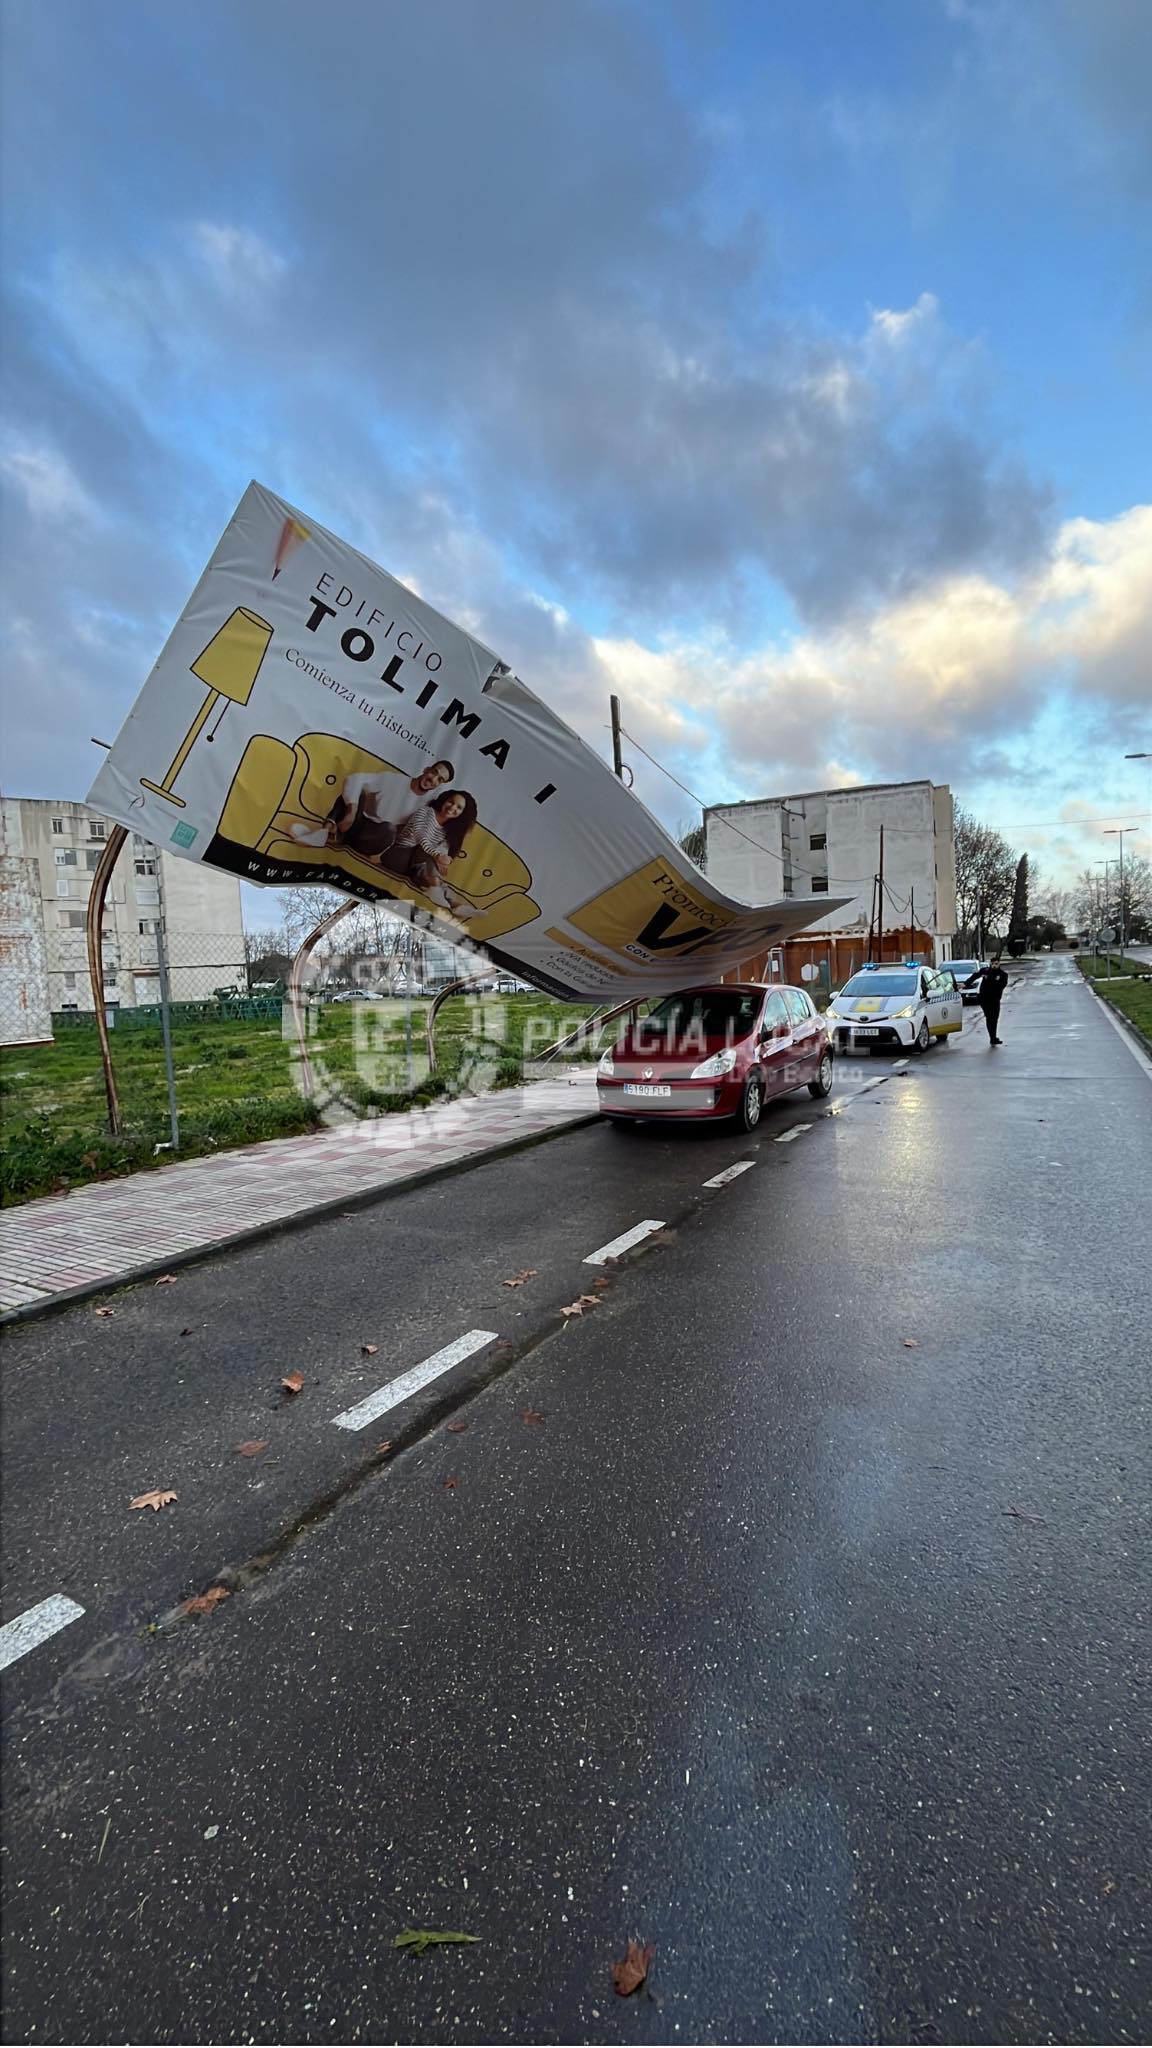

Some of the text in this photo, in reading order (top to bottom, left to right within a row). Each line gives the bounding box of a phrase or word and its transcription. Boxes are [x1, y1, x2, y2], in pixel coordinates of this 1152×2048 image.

[315, 572, 442, 672] EDIFICIO
[285, 648, 356, 703] Comienza
[358, 698, 374, 716] tu
[305, 595, 557, 805] TOLIMA I
[625, 944, 649, 959] CON
